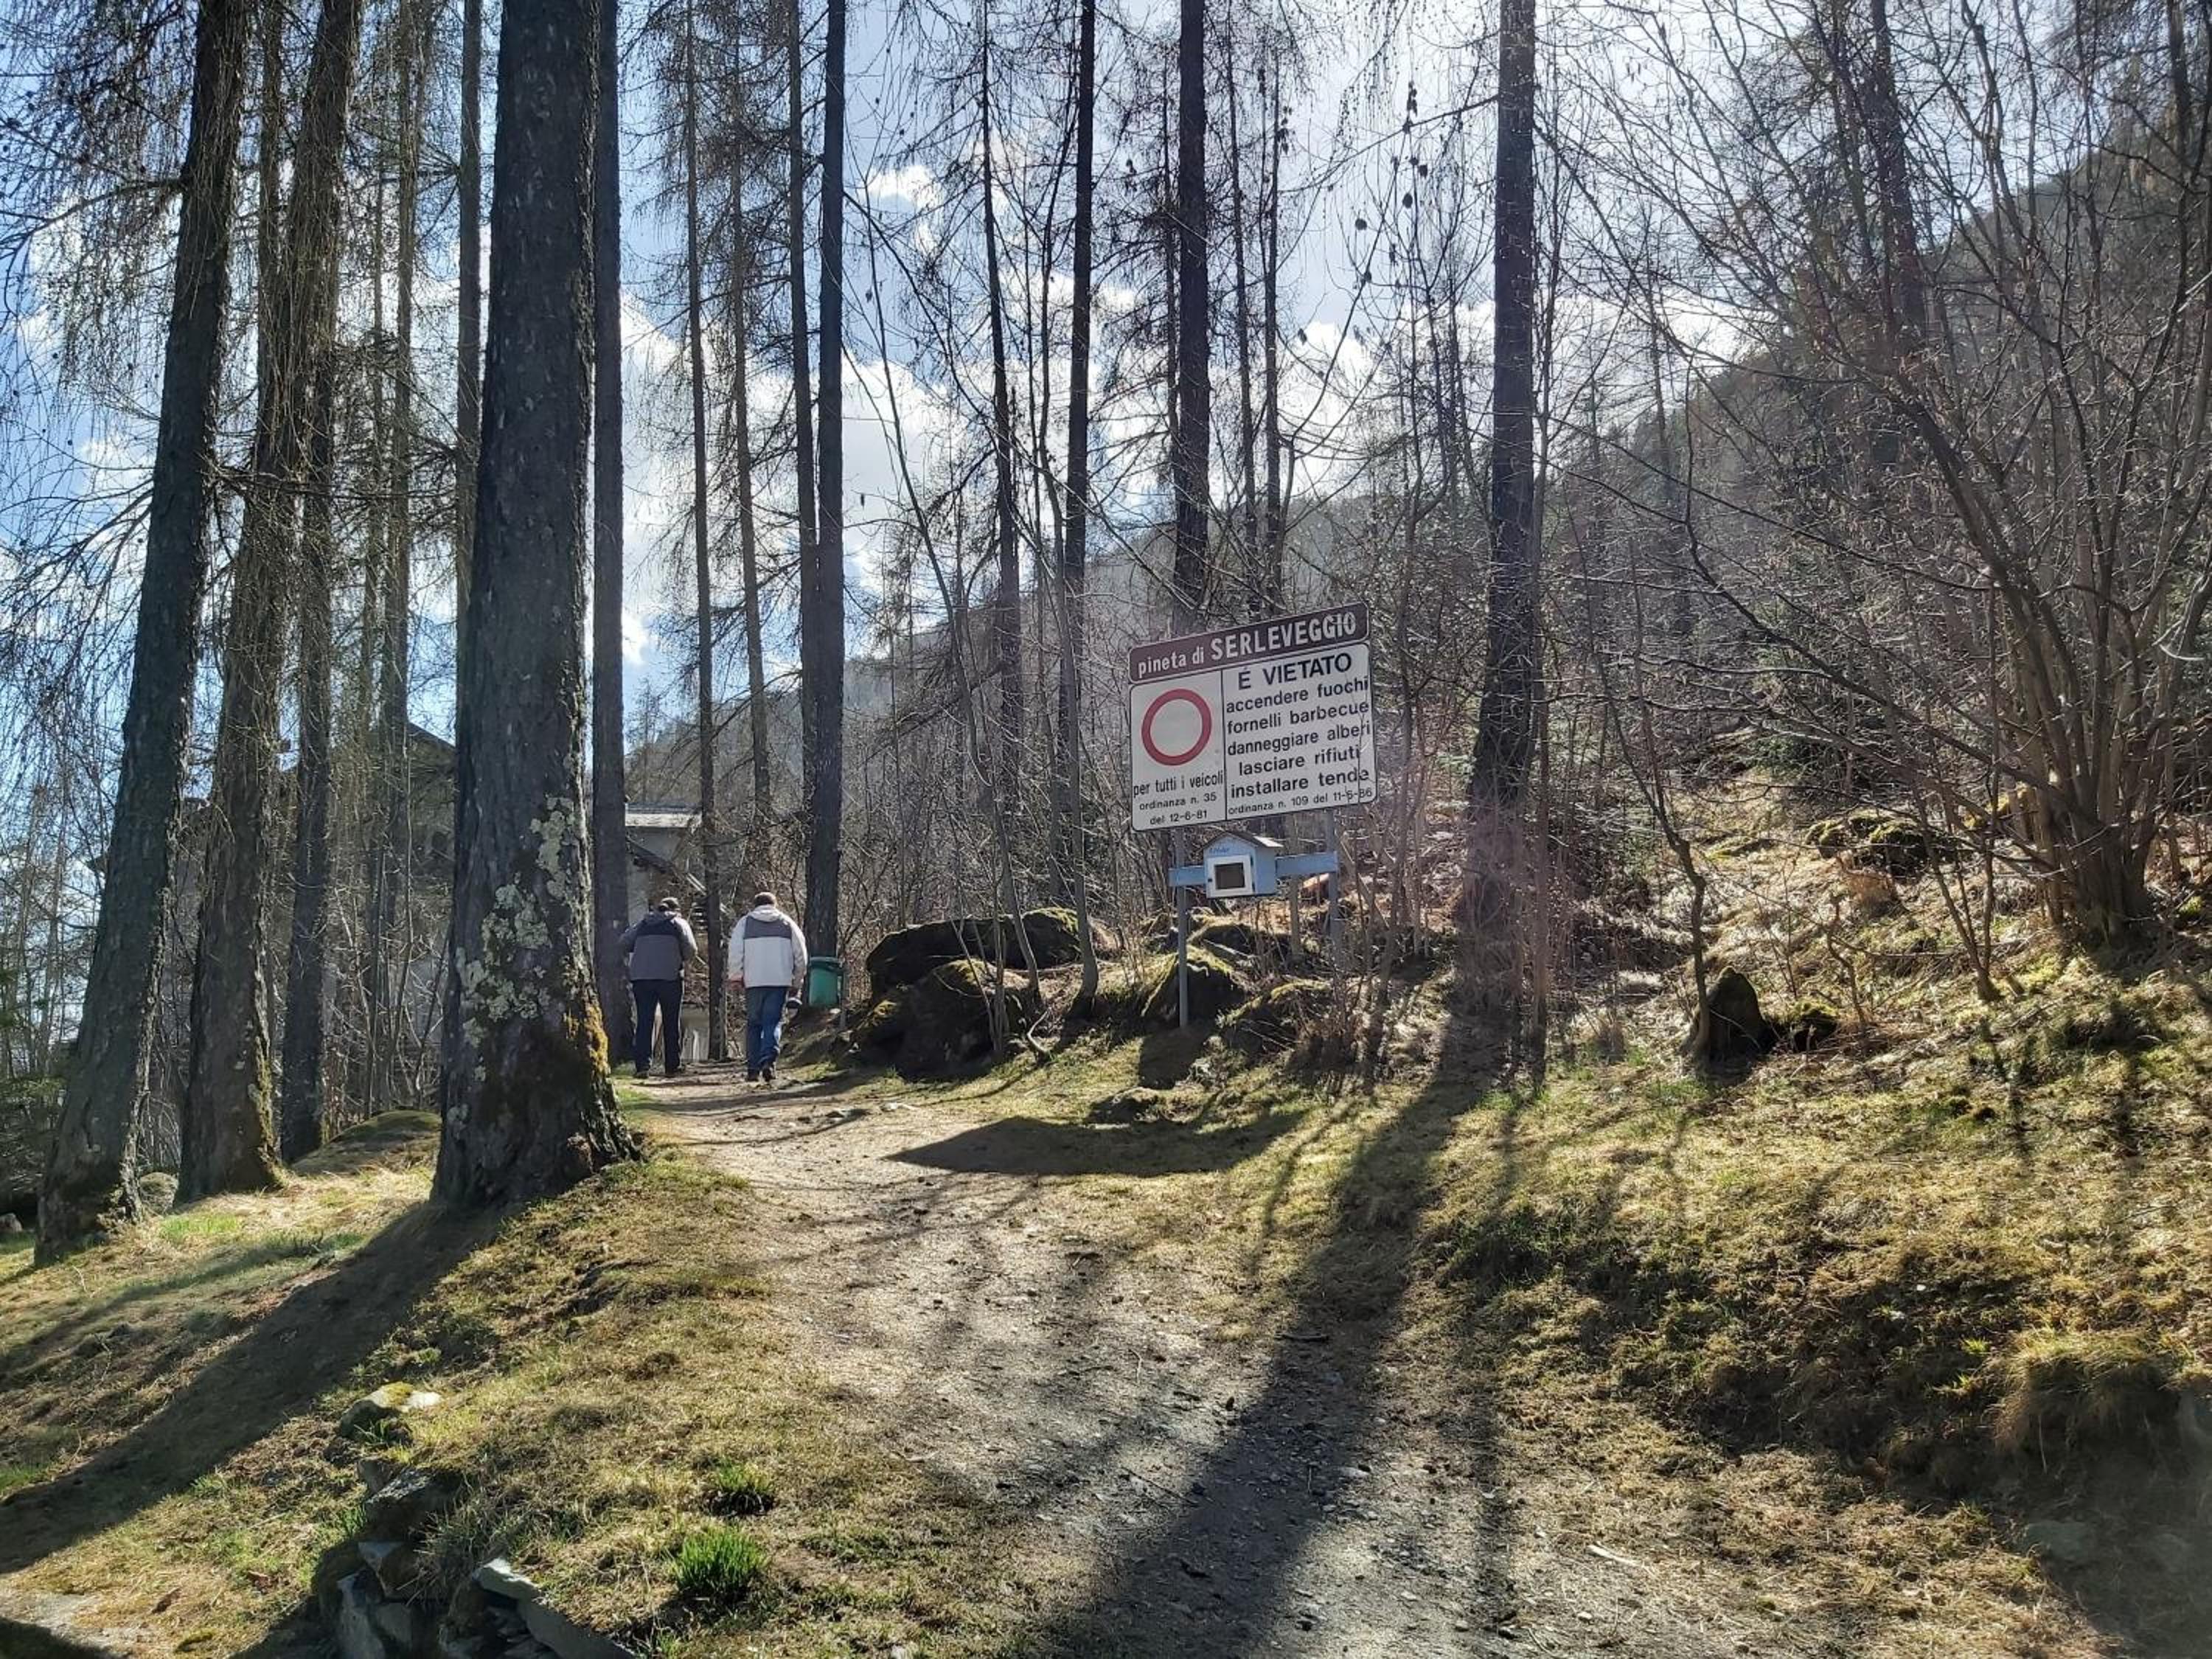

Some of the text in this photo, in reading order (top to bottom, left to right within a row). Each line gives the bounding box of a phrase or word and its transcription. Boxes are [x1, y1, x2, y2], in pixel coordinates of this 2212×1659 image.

[1138, 611, 1356, 678] pineta di SERLEVEGGIO
[1263, 653, 1352, 685] VIETATO
[1227, 676, 1369, 713] accendere fuochi
[1228, 700, 1369, 734] fornelli barbecue
[1228, 720, 1370, 756] danneggiare alberi
[1239, 744, 1360, 776] lasciare rifiuti
[1133, 770, 1223, 798] per tutti i veicoli
[1231, 767, 1369, 799] installare tende
[1139, 798, 1186, 810] ordinanza
[1150, 815, 1164, 824] del
[1228, 801, 1273, 815] ordinanza
[1291, 796, 1308, 807] 109
[1313, 793, 1328, 804] del
